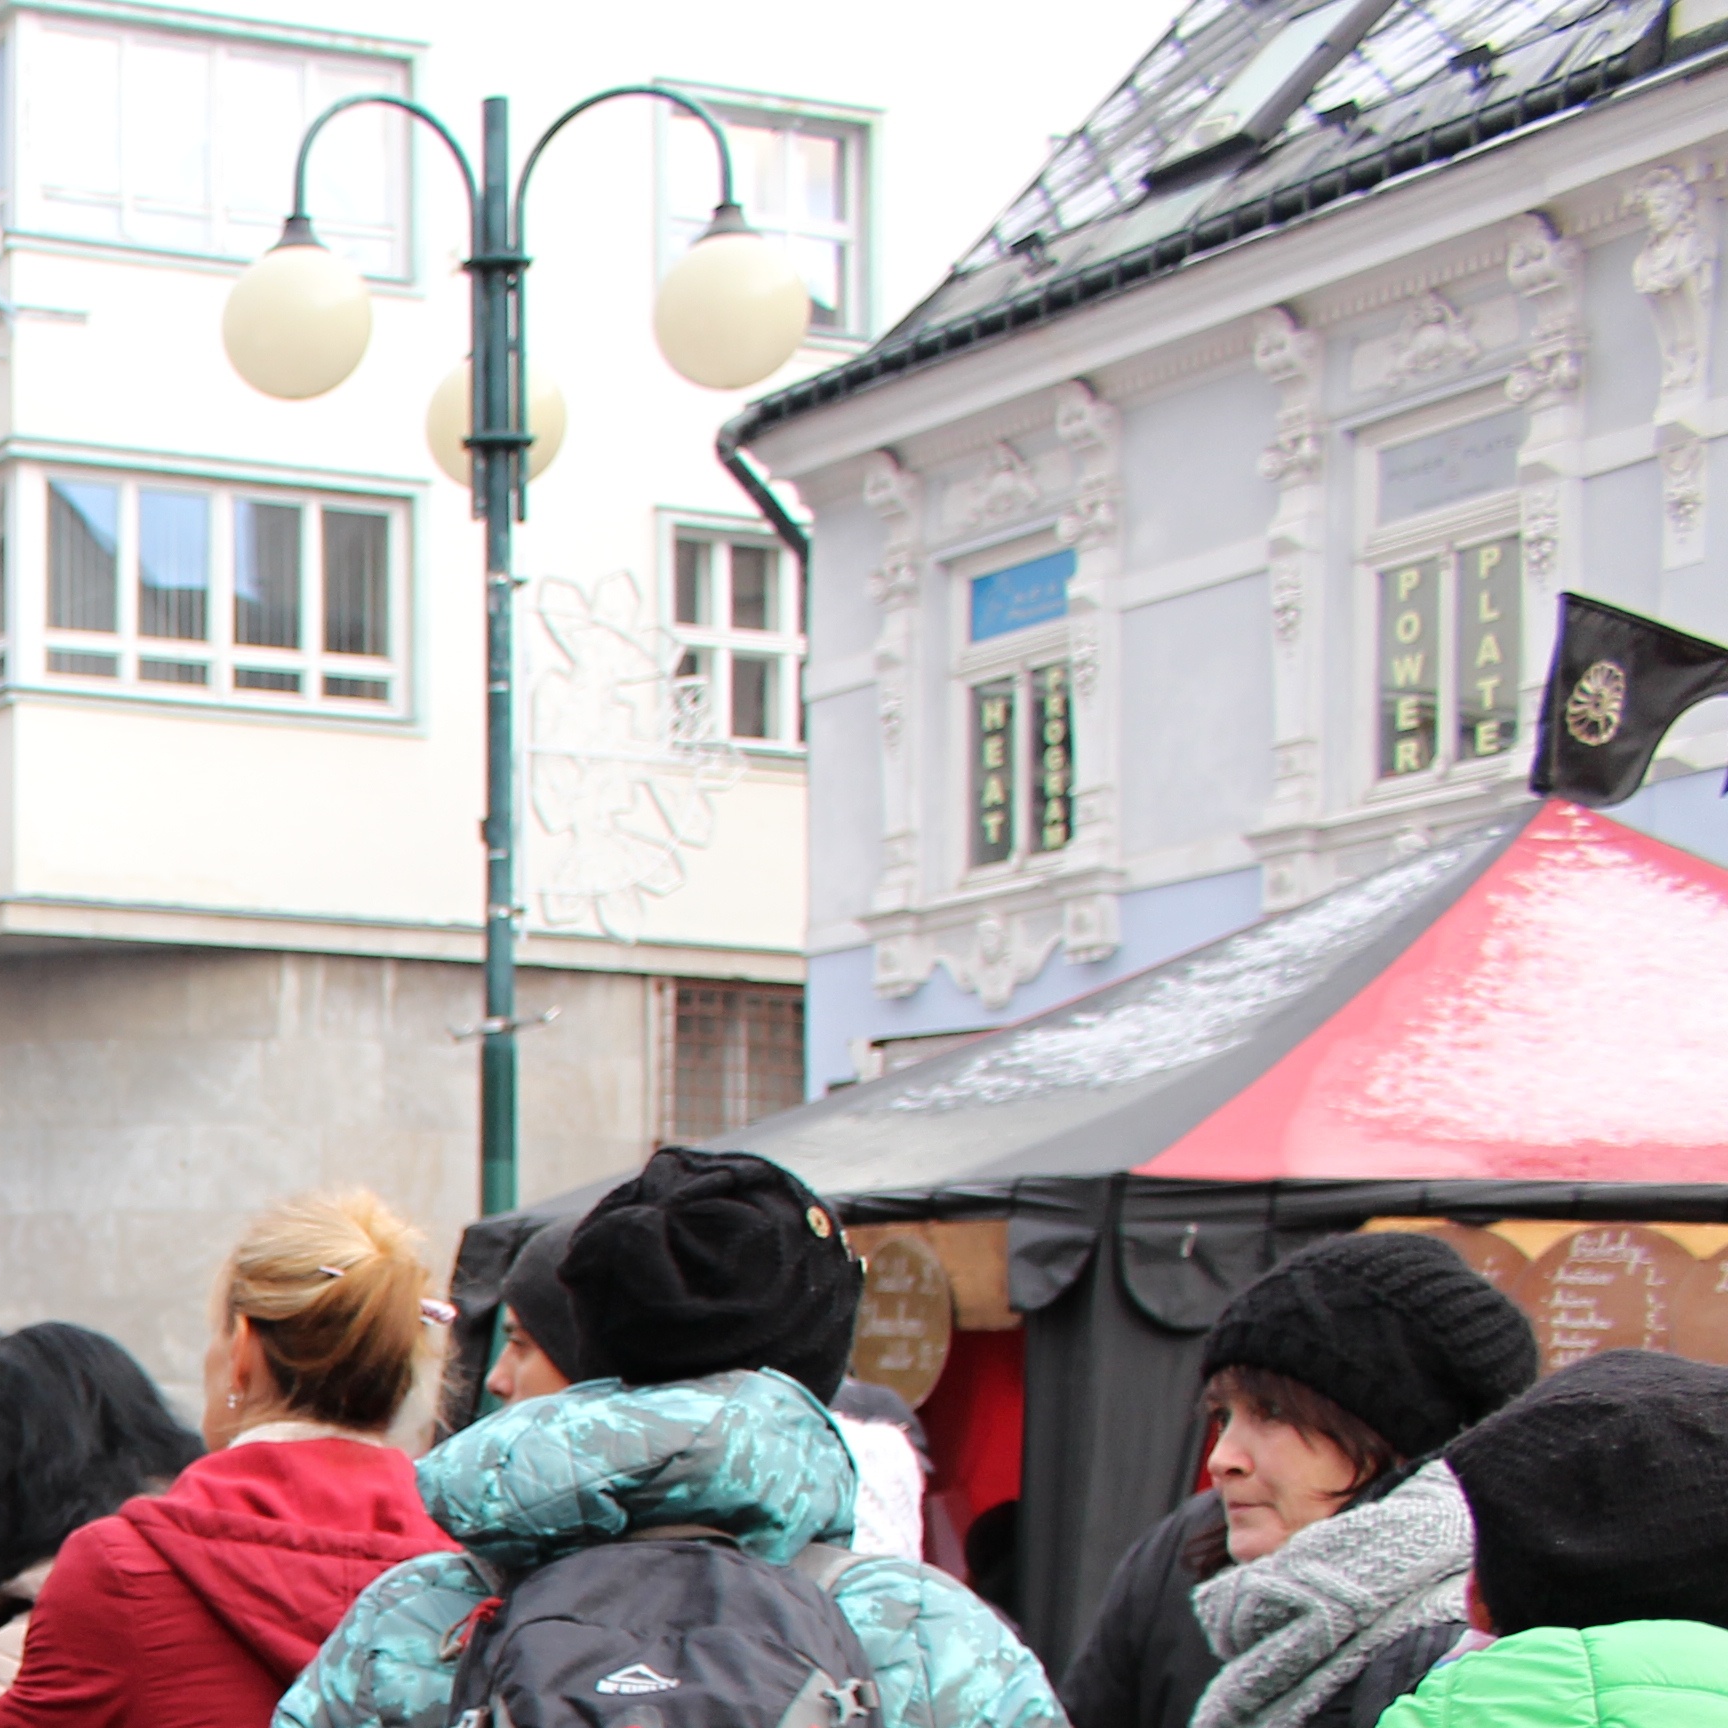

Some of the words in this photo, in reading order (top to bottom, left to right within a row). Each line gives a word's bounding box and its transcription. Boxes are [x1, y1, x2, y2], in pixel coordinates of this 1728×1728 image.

[1393, 567, 1425, 775] POWER
[1474, 545, 1503, 756] PLATE
[980, 695, 1008, 845] HEAT
